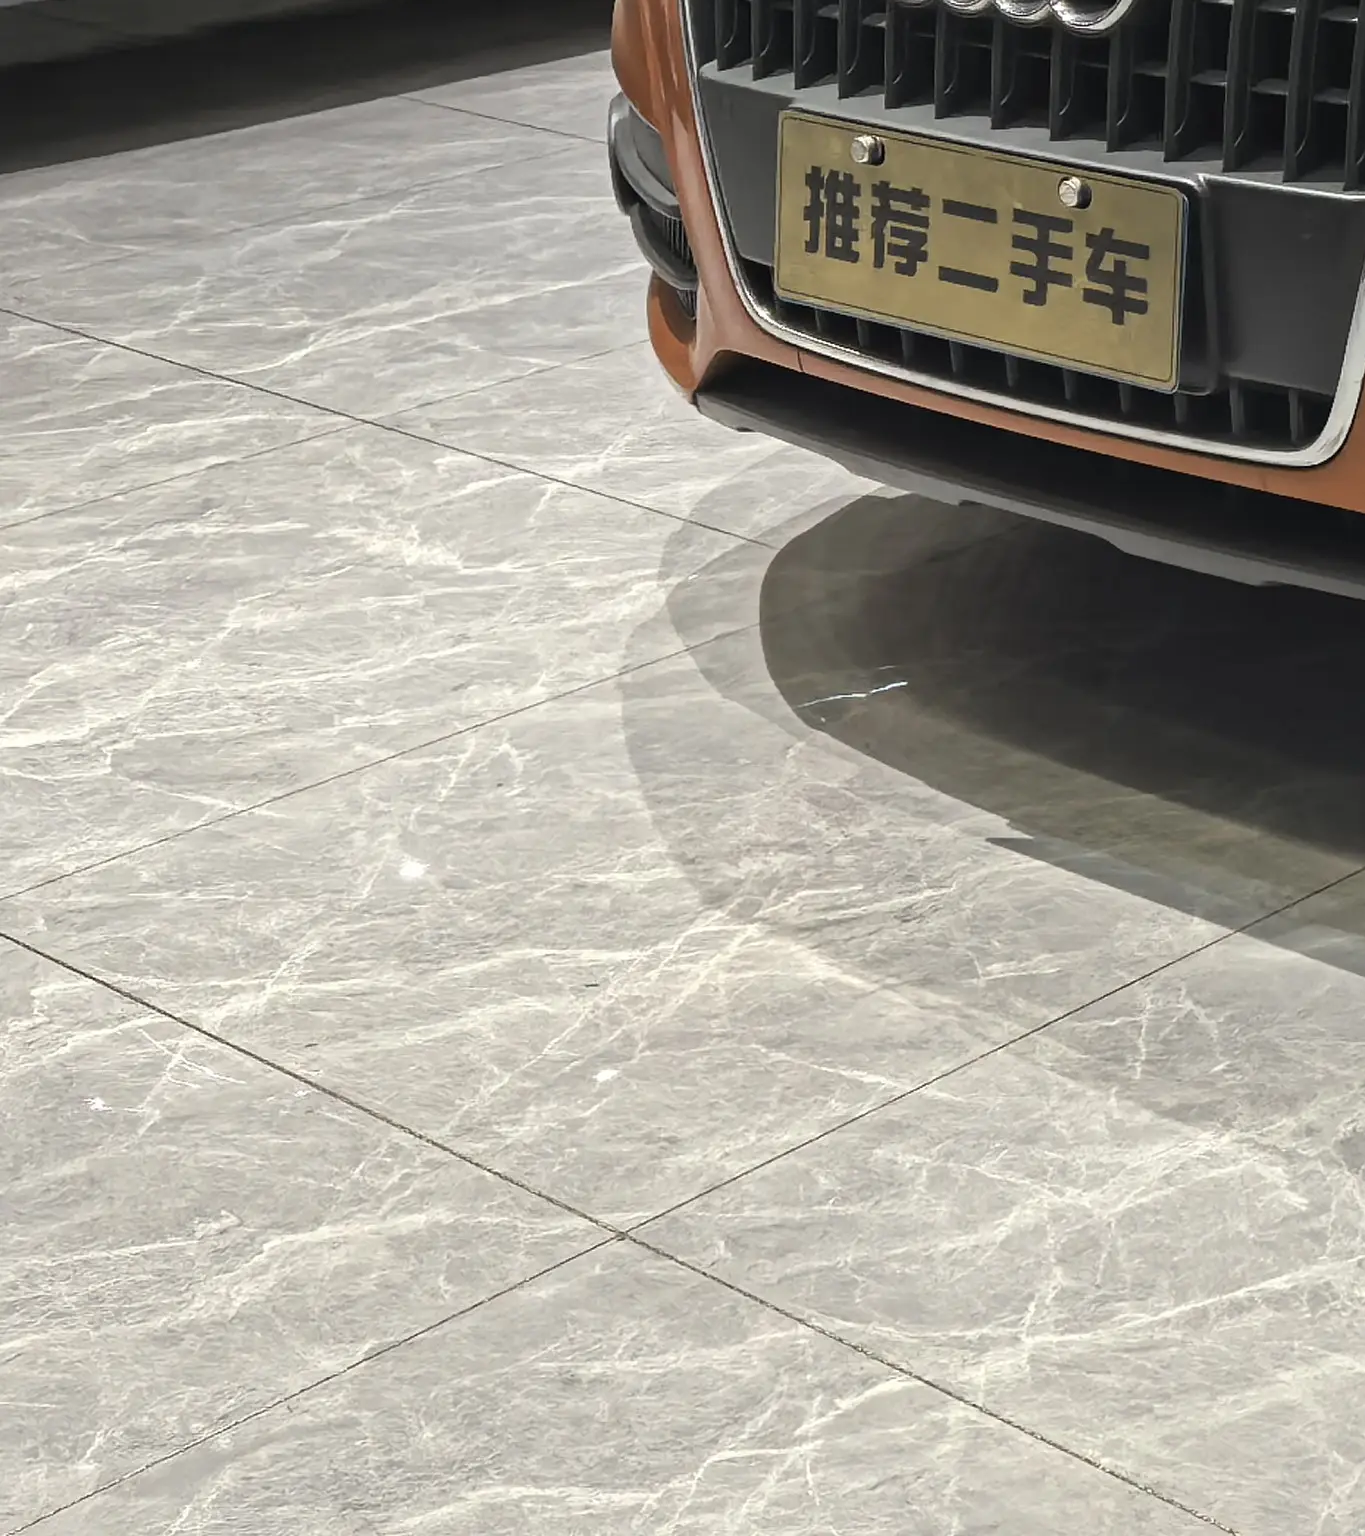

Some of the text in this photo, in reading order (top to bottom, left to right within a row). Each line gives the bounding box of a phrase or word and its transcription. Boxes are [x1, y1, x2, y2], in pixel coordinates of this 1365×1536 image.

[804, 165, 1150, 325] 推荐二手车
